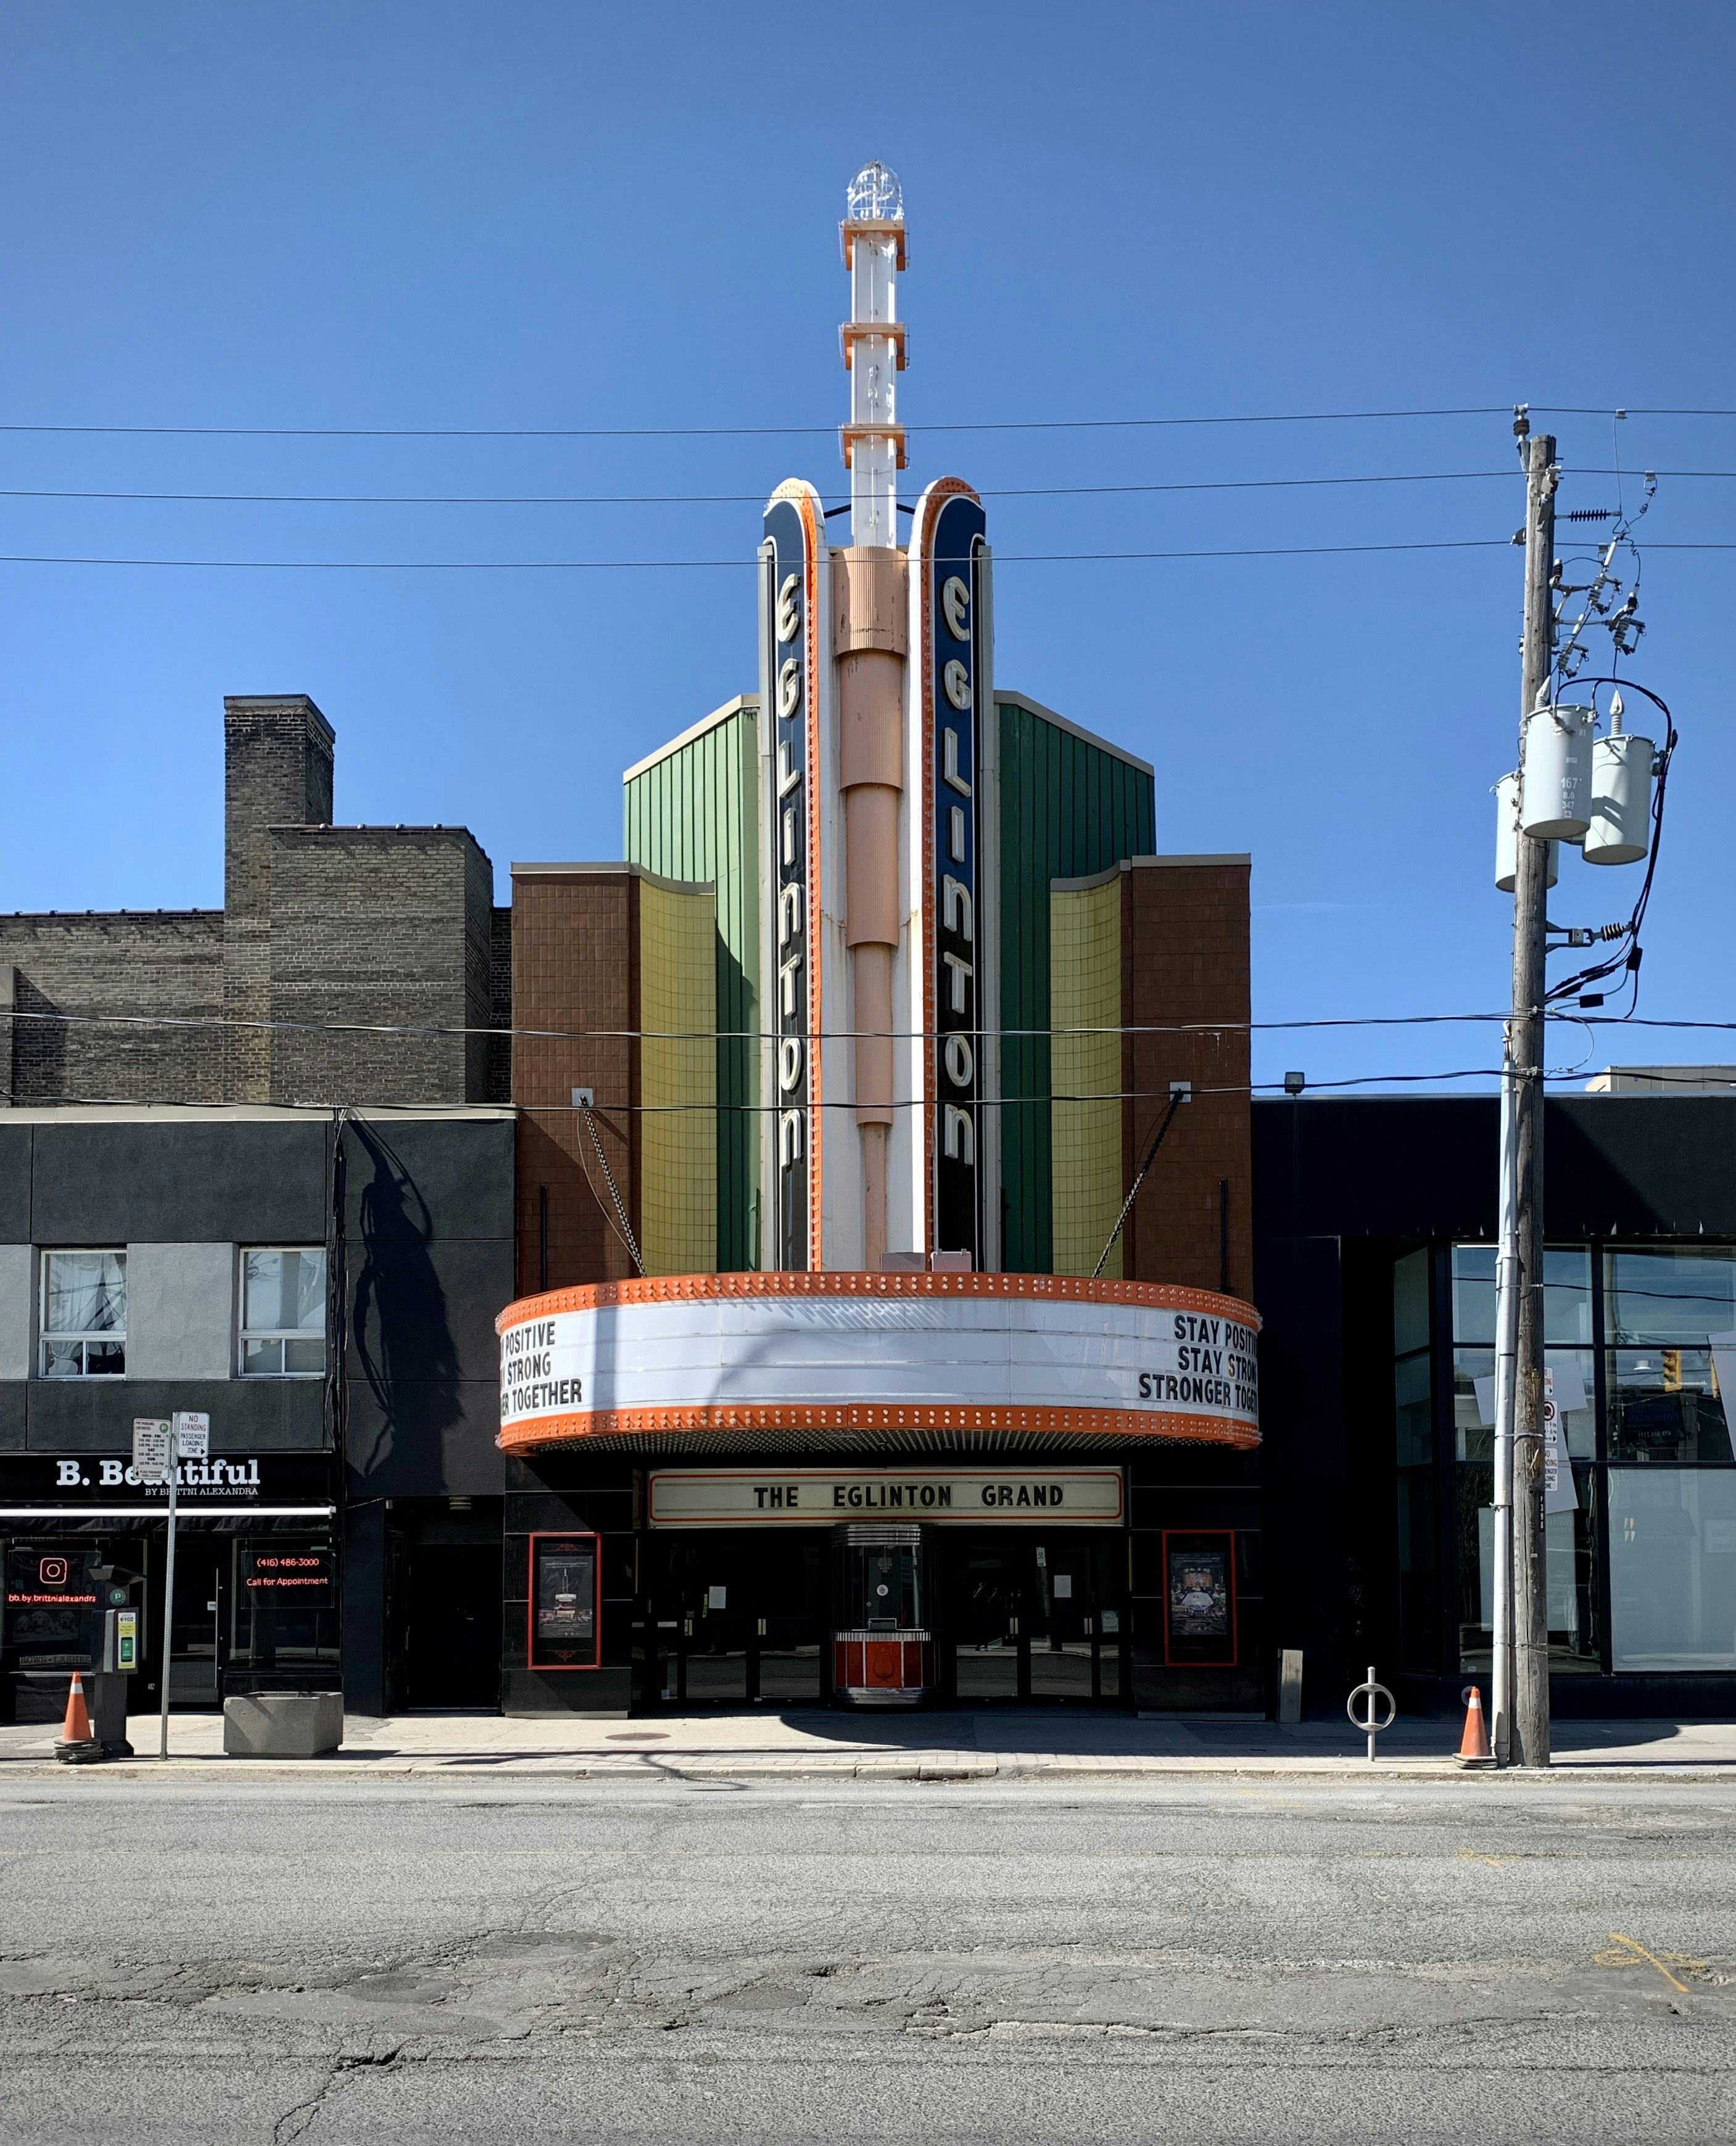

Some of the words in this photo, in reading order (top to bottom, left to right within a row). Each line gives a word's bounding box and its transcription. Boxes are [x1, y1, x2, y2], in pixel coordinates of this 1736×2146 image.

[1560, 777, 1578, 789] 167
[1562, 791, 1575, 799] 8.0
[506, 1321, 555, 1357] POSITIVE
[1175, 1314, 1220, 1345] STAY
[507, 1352, 551, 1385] STRONG
[1178, 1345, 1222, 1374] STAY
[512, 1378, 582, 1412] TOGETHER
[1139, 1373, 1231, 1406] STRONGER
[181, 1423, 206, 1432] STANDING
[56, 1460, 90, 1486] B.
[145, 1488, 157, 1496] BY
[159, 1488, 197, 1496] BRTTNI
[199, 1487, 258, 1495] ALEXANDRA
[754, 1486, 798, 1508] THE
[833, 1485, 952, 1507] EGLINTON
[982, 1484, 1064, 1507] GRAND
[257, 1558, 278, 1567] (416)
[280, 1558, 320, 1566] 486-3000
[247, 1578, 261, 1586] Call
[263, 1577, 276, 1586] for
[277, 1577, 328, 1587] Appointment
